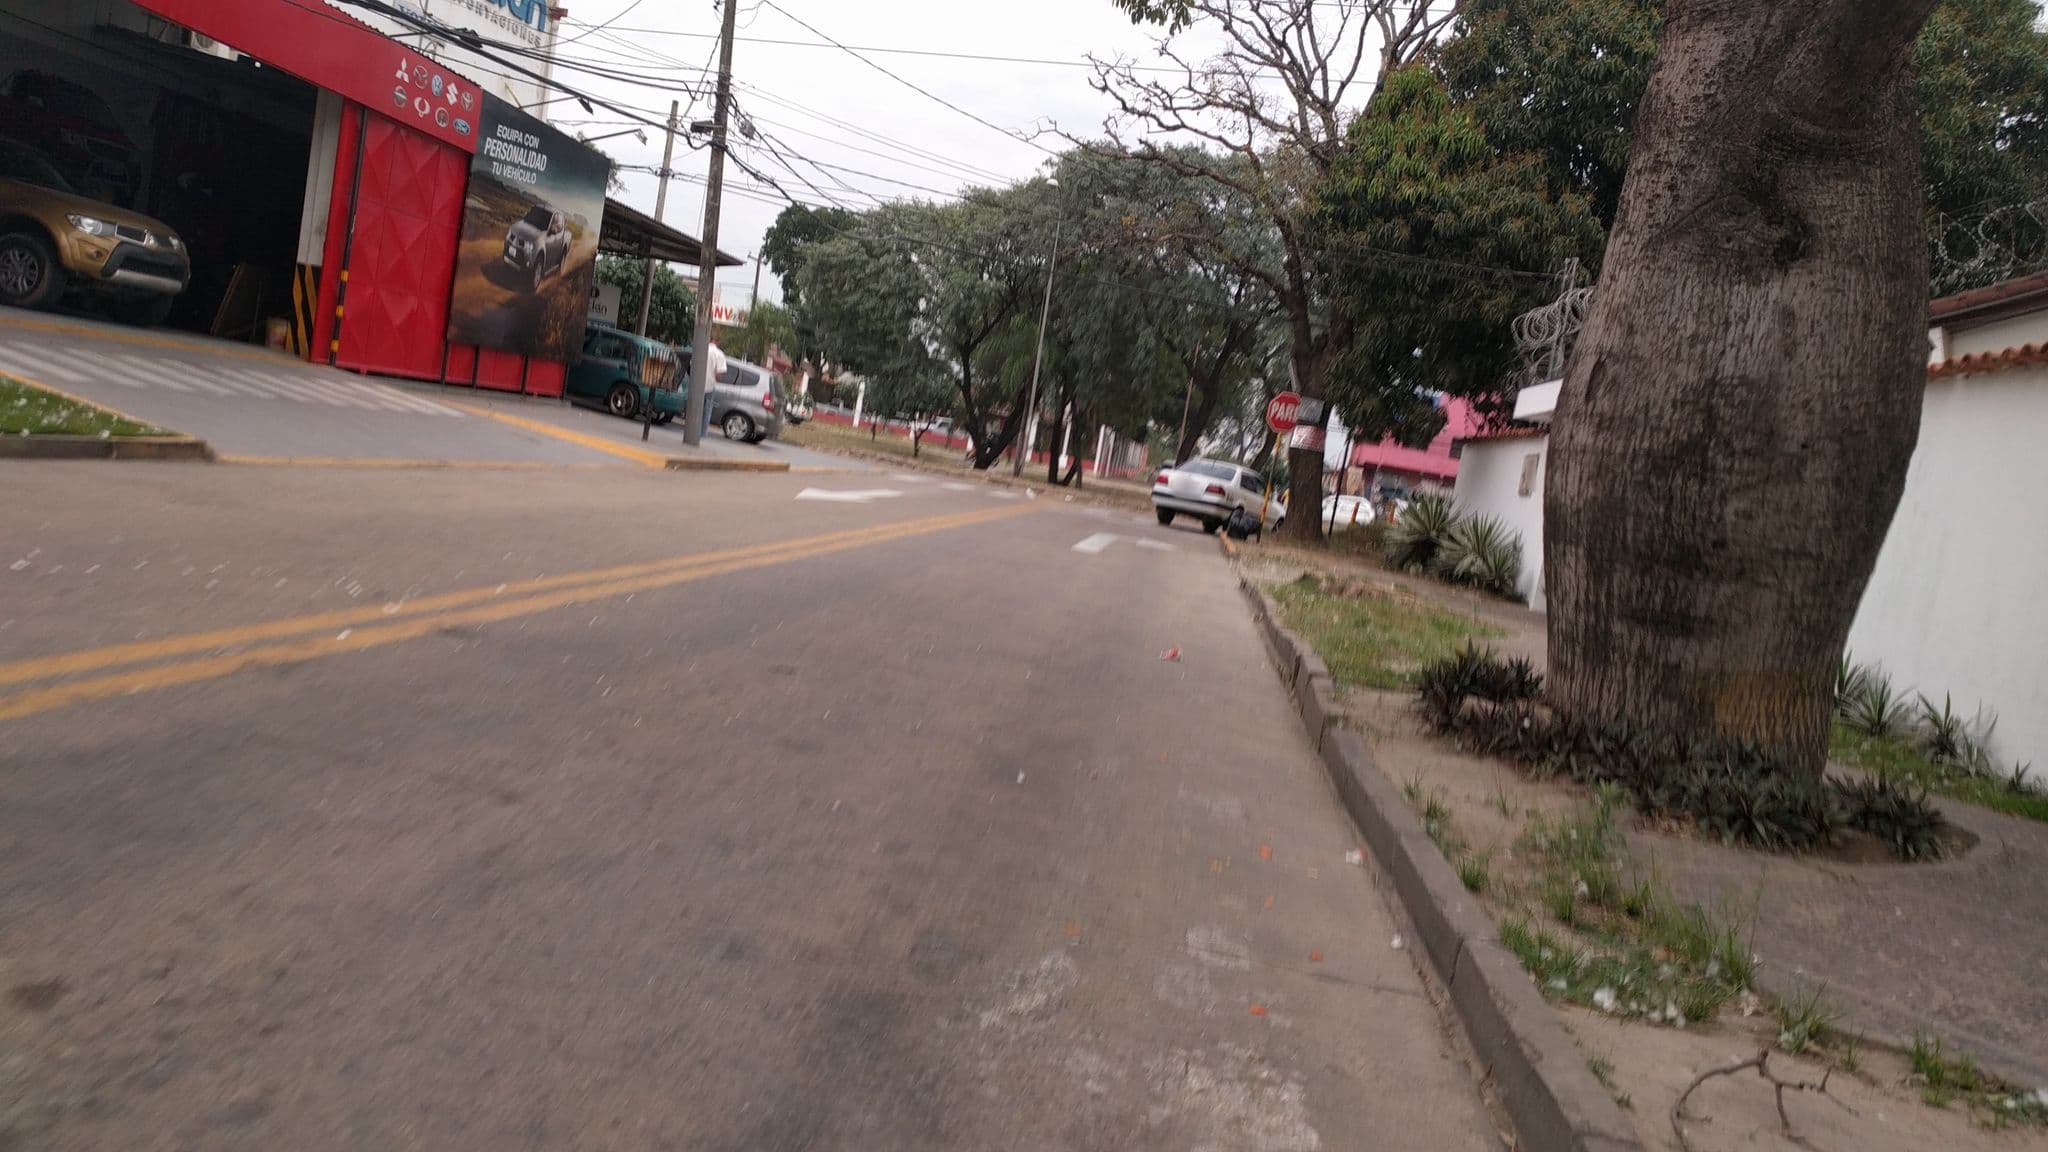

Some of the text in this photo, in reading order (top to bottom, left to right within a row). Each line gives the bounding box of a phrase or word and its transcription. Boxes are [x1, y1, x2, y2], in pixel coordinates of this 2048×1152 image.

[496, 124, 540, 149] EQUIPA CON
[483, 136, 548, 172] PERSONALIDAD
[492, 161, 537, 185] TU VEHÍCULO
